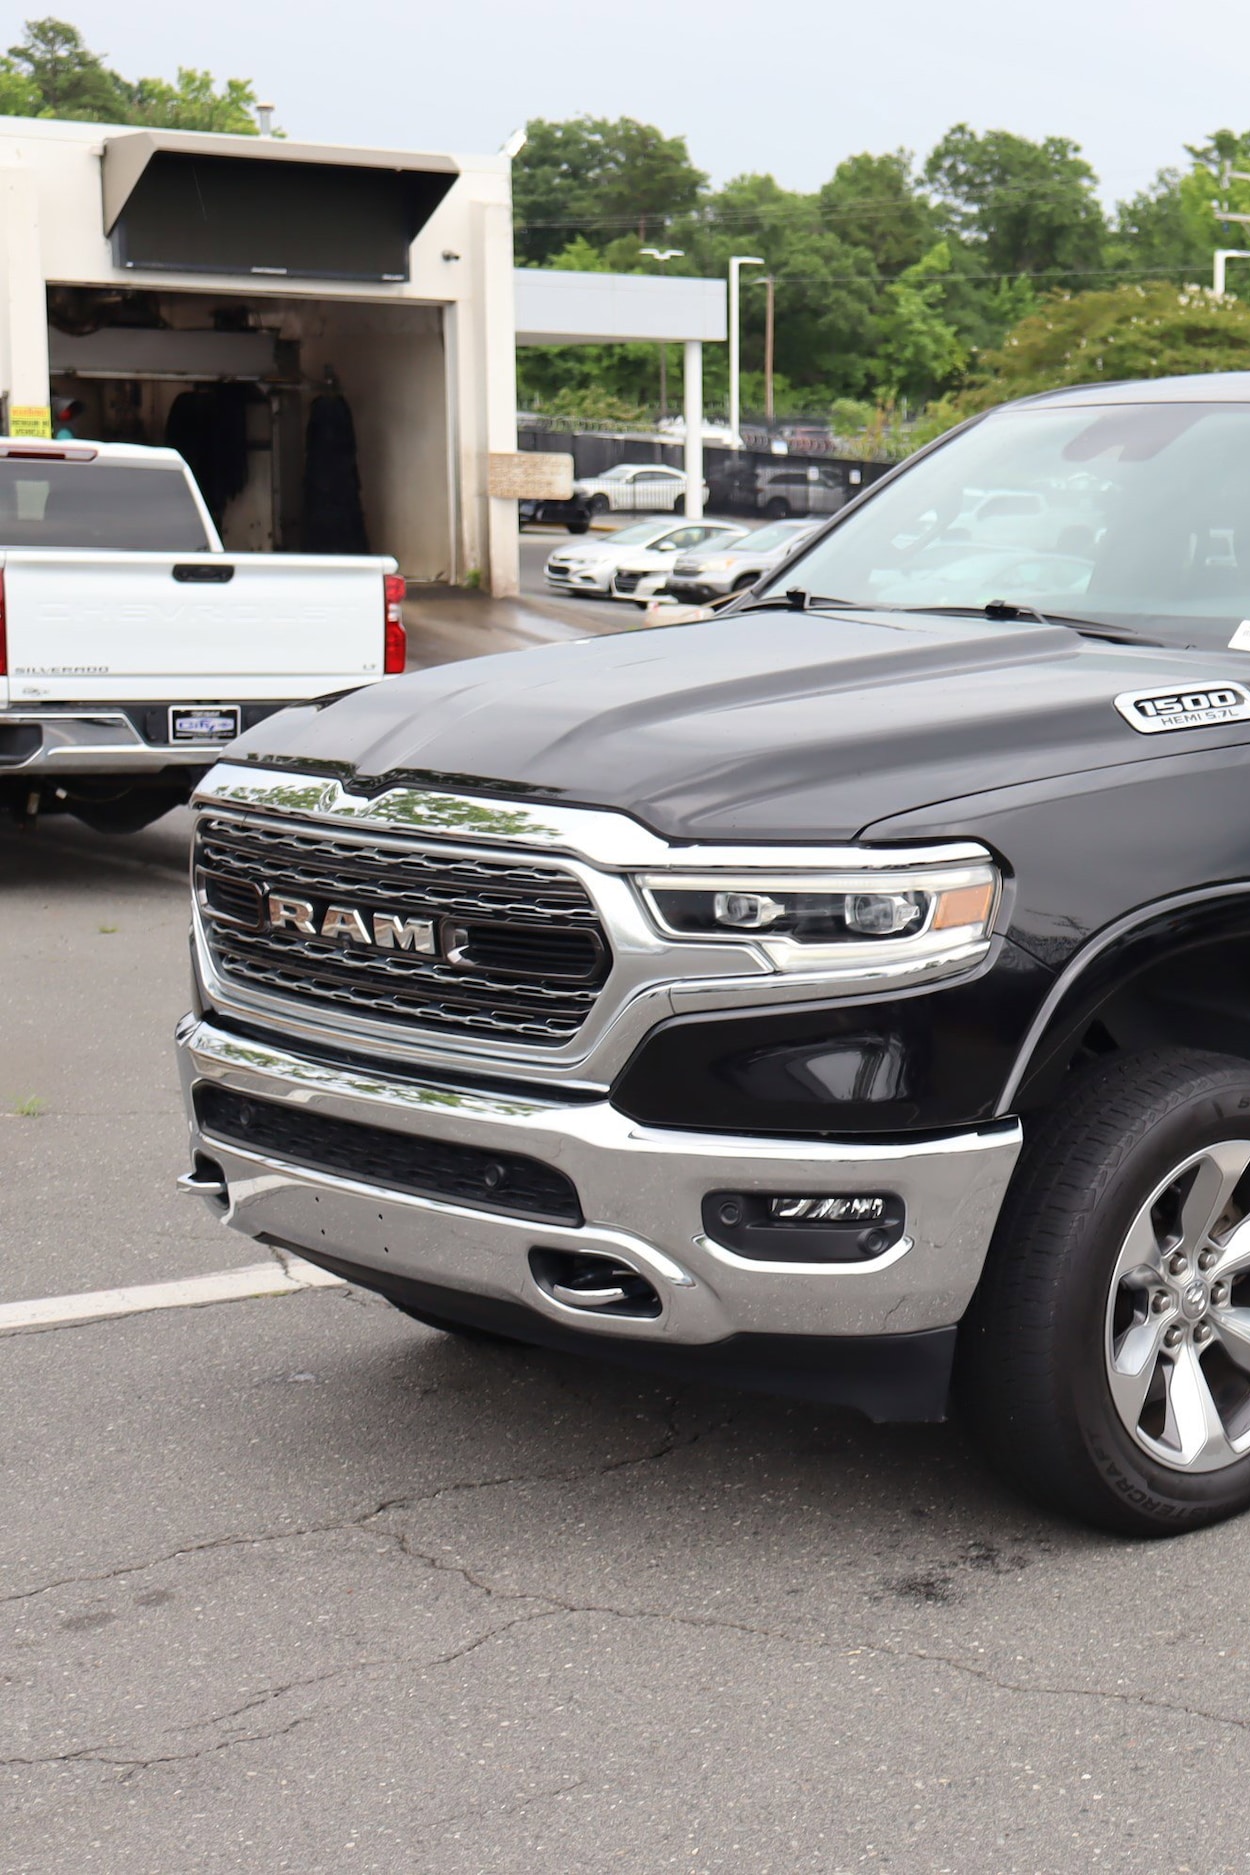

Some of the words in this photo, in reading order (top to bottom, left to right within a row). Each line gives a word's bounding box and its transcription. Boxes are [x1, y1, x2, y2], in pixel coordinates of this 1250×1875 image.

[1137, 690, 1237, 717] 1500
[1161, 712, 1202, 726] HEMI
[1206, 709, 1239, 720] 5.7L
[268, 895, 436, 955] RAM
